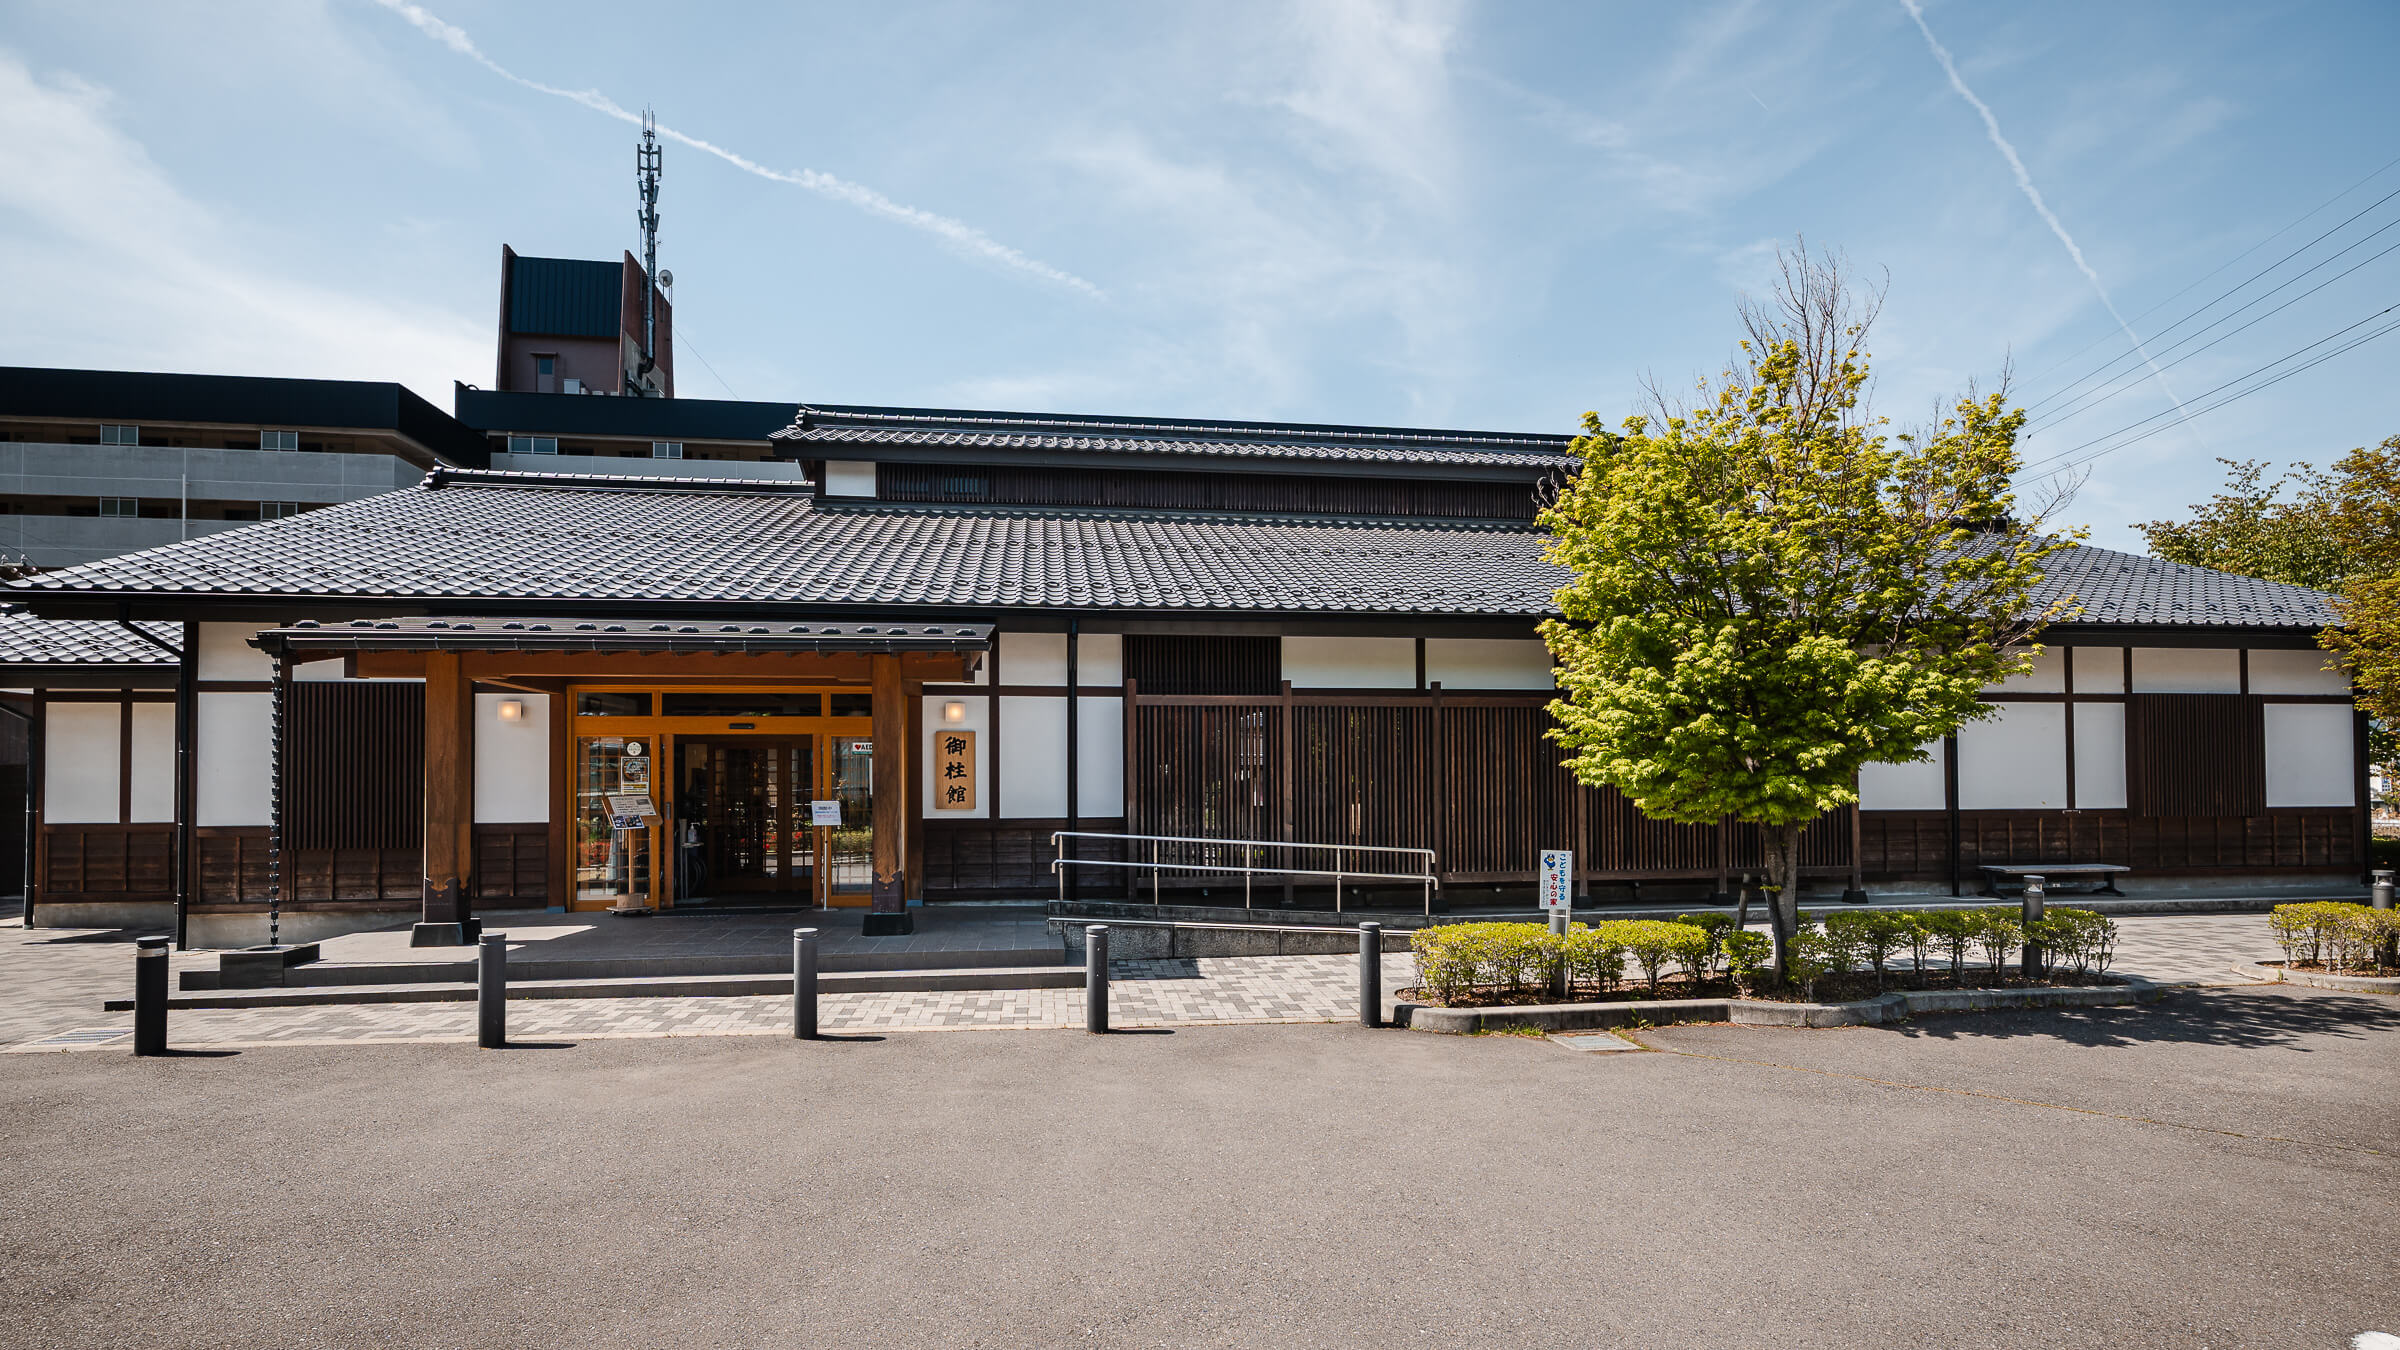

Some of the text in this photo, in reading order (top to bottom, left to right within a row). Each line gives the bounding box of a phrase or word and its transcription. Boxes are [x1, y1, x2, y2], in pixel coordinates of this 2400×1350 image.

[944, 736, 968, 804] 御柱館
[1550, 874, 1558, 906] 安心の家
[1558, 853, 1566, 900] こどもを守る
